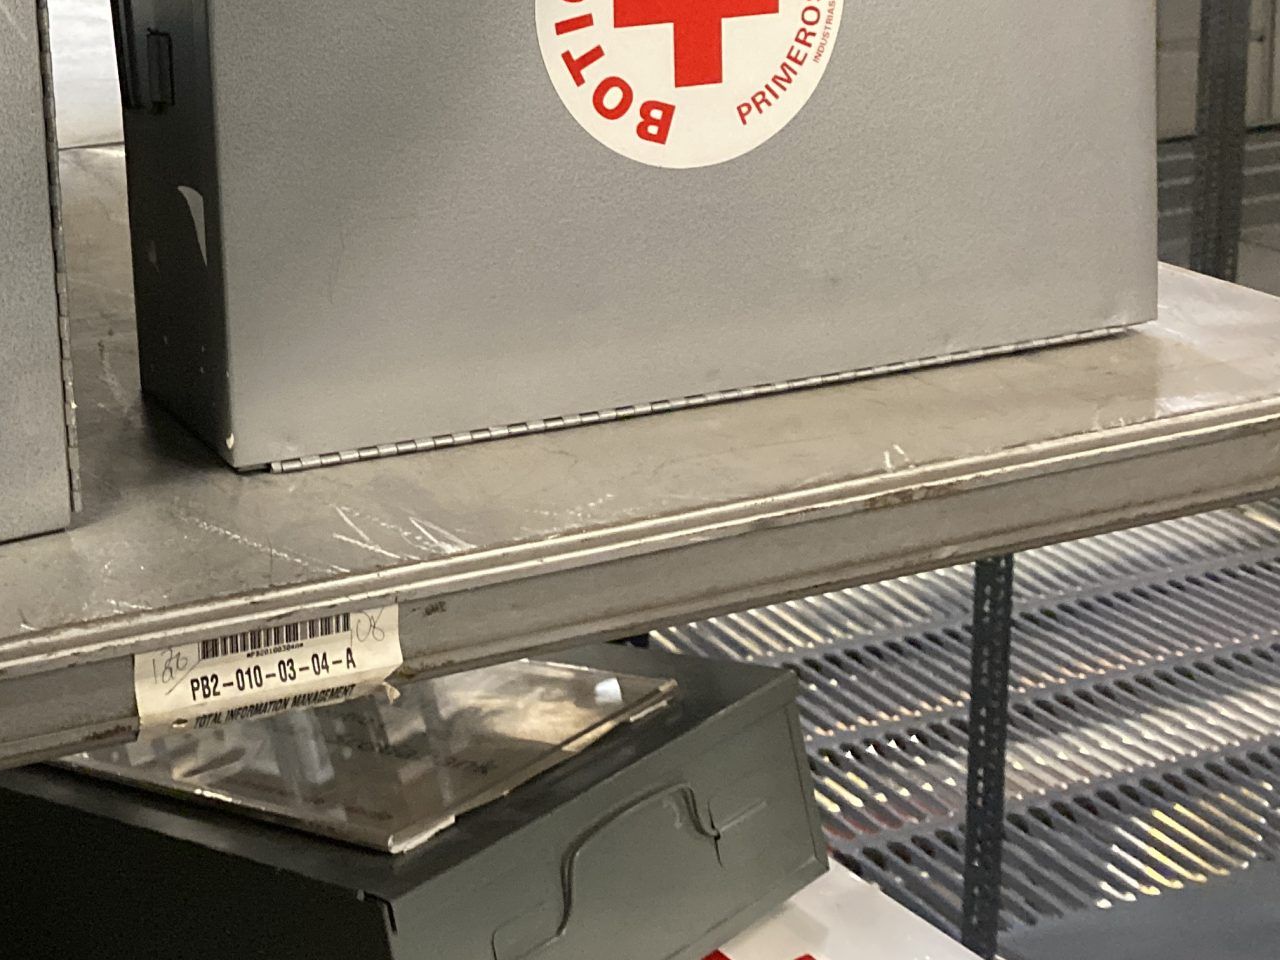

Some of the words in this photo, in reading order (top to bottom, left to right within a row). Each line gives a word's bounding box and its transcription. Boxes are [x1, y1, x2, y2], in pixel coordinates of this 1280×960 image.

[813, 0, 836, 63] INDUSTRIAS
[190, 646, 357, 702] PB2-010-03-04-A
[193, 711, 223, 729] TOTAL
[224, 697, 290, 723] INFORMATION
[290, 683, 357, 708] MANAGEMENT
